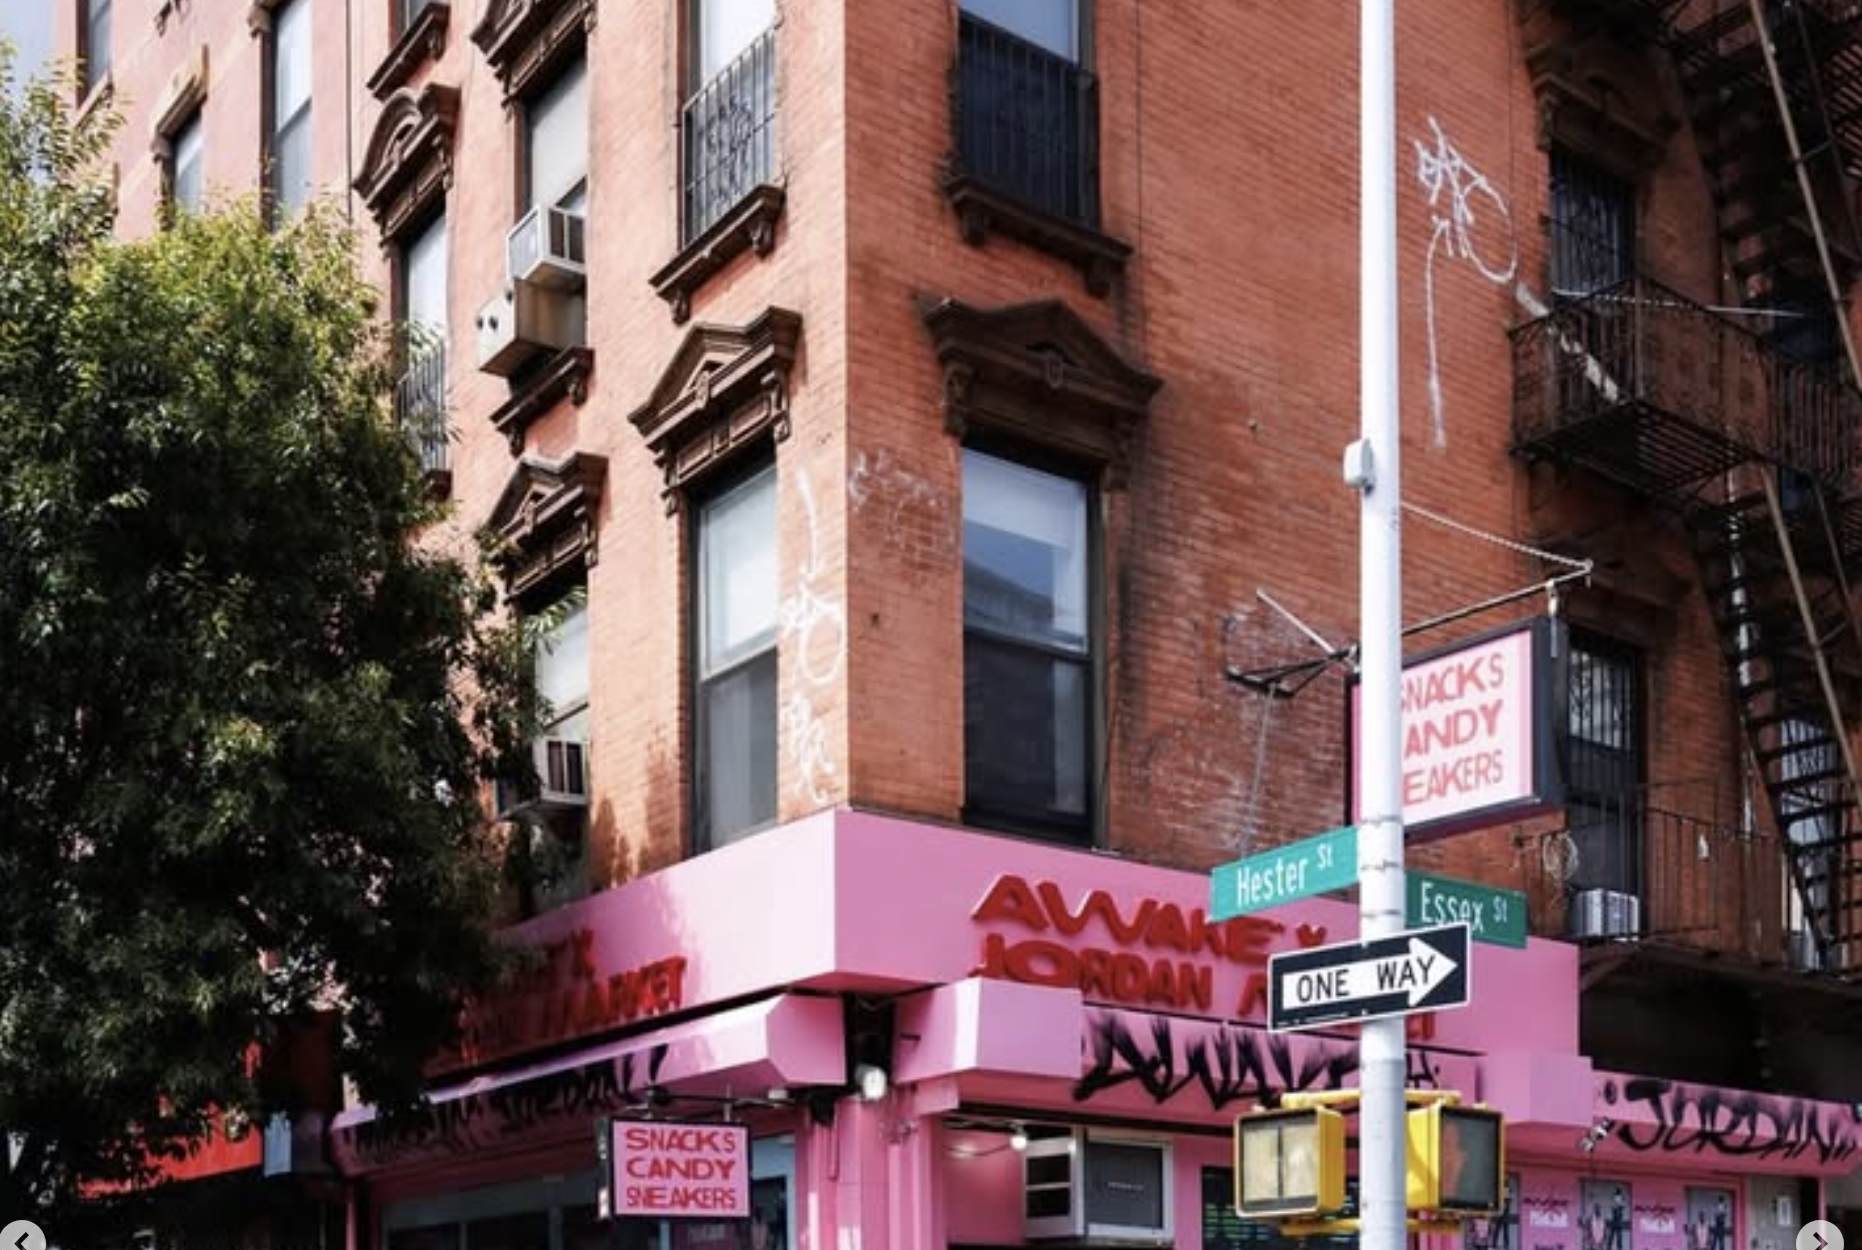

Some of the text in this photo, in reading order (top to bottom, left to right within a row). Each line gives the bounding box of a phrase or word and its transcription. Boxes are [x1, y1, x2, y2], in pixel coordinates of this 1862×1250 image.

[1401, 653, 1504, 713] NACKS
[1404, 699, 1503, 759] ANDY
[1403, 750, 1504, 806] EAKERS
[1236, 843, 1333, 909] Hester St
[971, 875, 1284, 964] AWAKE
[1422, 881, 1507, 933] Essex St
[968, 933, 1212, 1011] JORDAN
[1297, 969, 1350, 1003] ONE
[1377, 955, 1435, 991] WAY
[626, 1128, 736, 1153] SNACKS
[626, 1156, 735, 1180] CANDY
[626, 1186, 736, 1209] SNEAKERS
